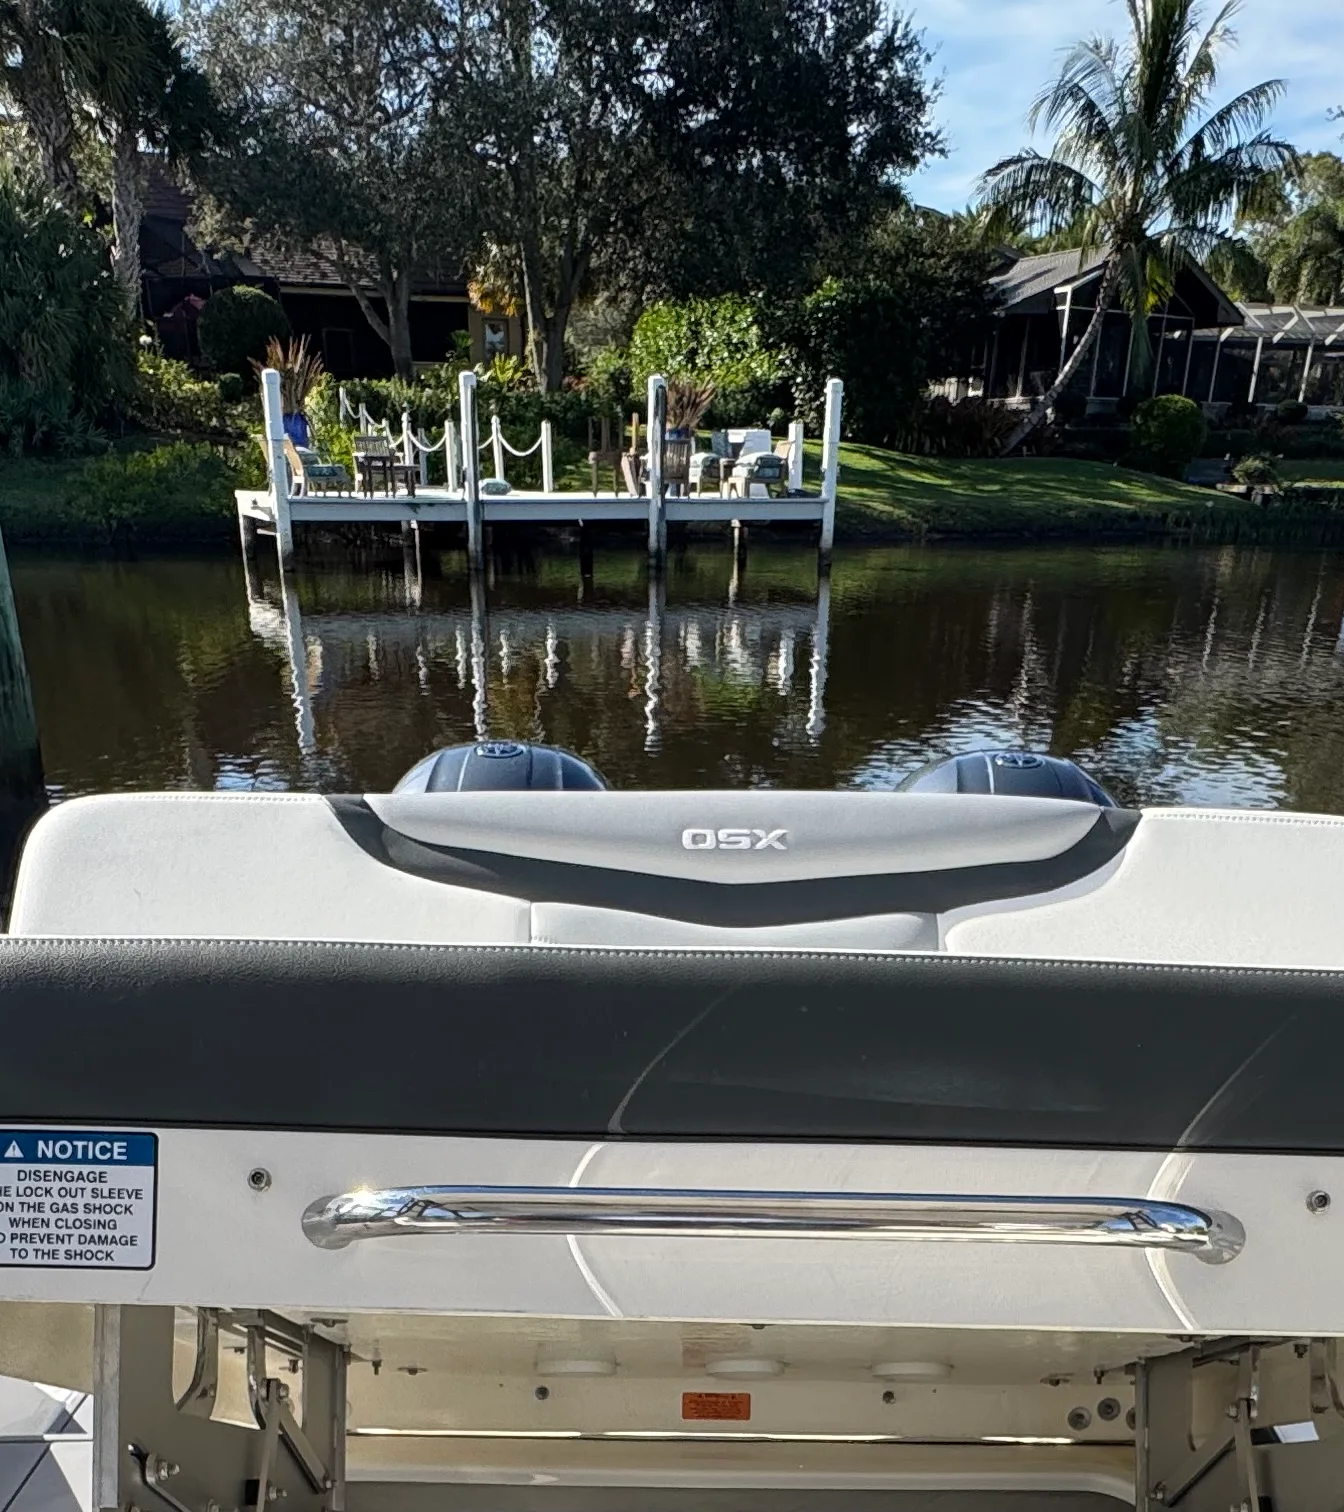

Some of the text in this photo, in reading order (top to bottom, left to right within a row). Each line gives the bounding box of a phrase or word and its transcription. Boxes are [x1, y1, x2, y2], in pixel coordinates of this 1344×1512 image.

[682, 828, 789, 850] OSX
[37, 1140, 128, 1160] NOTICE
[17, 1170, 108, 1184] DISENGAGE
[16, 1186, 54, 1198] LOCK
[58, 1187, 86, 1199] OUT
[91, 1188, 143, 1200] SLEEVE
[18, 1202, 45, 1213] THE
[50, 1203, 79, 1214] GAS
[83, 1203, 134, 1215] SHOCK
[9, 1217, 118, 1230] WHEN CLOSING
[11, 1232, 74, 1245] PREVENT
[78, 1234, 138, 1246] DAMAGE
[10, 1248, 114, 1261] TO THE SHOCK
